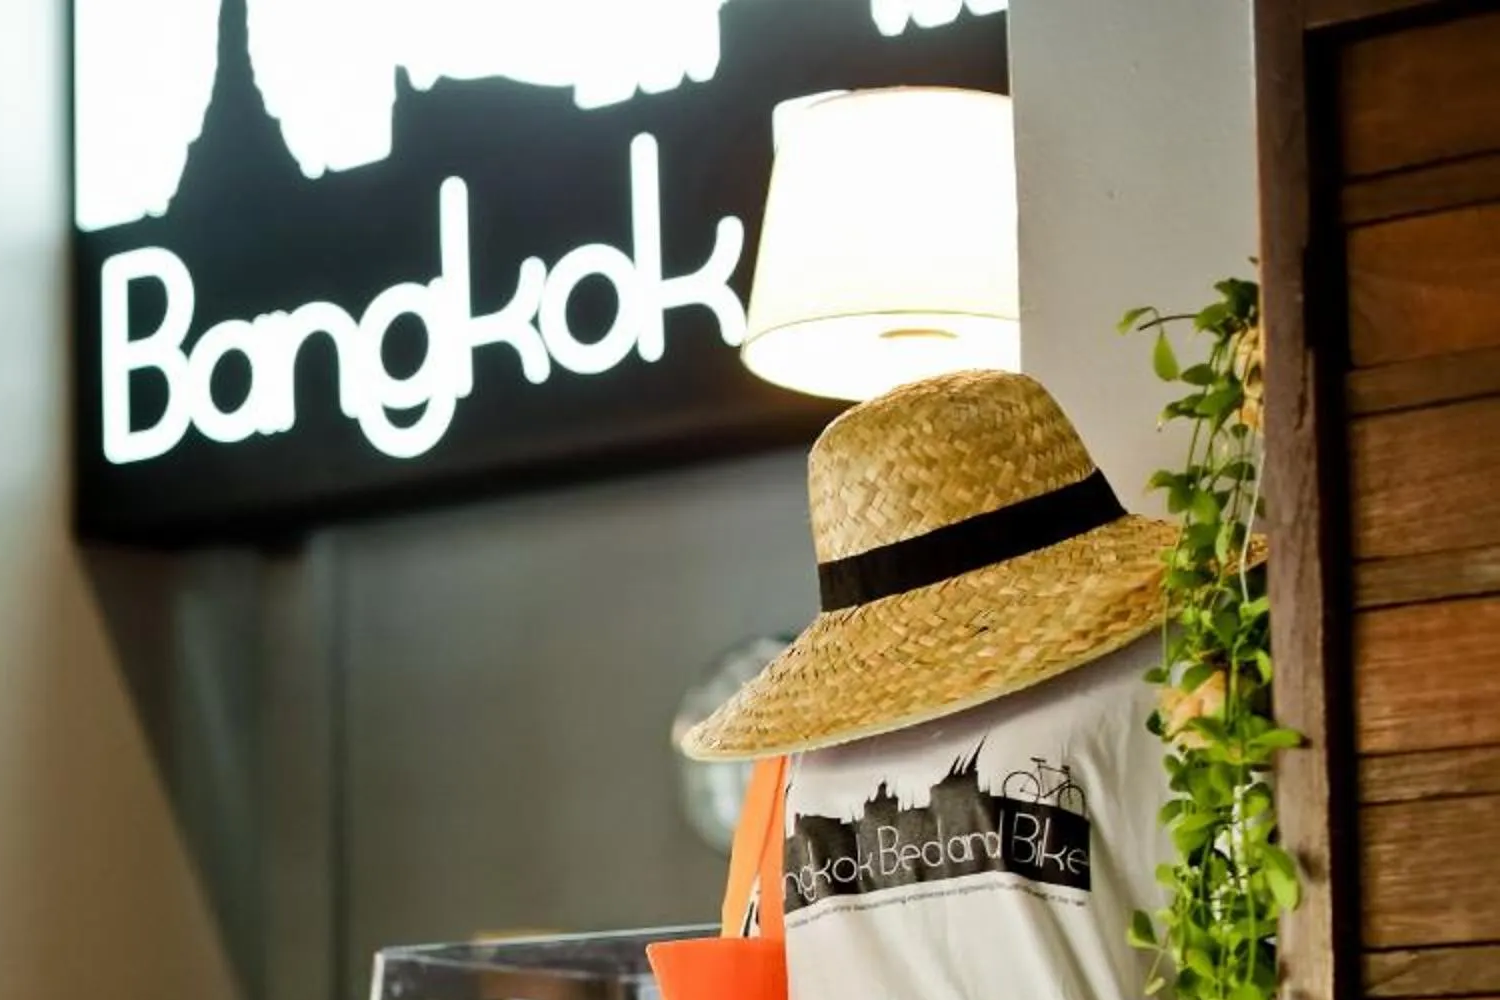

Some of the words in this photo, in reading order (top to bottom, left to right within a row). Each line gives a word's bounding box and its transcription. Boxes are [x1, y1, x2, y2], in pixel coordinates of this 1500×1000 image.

[102, 132, 746, 464] Bangkok
[783, 834, 874, 902] ngkok
[1012, 812, 1088, 875] Bike
